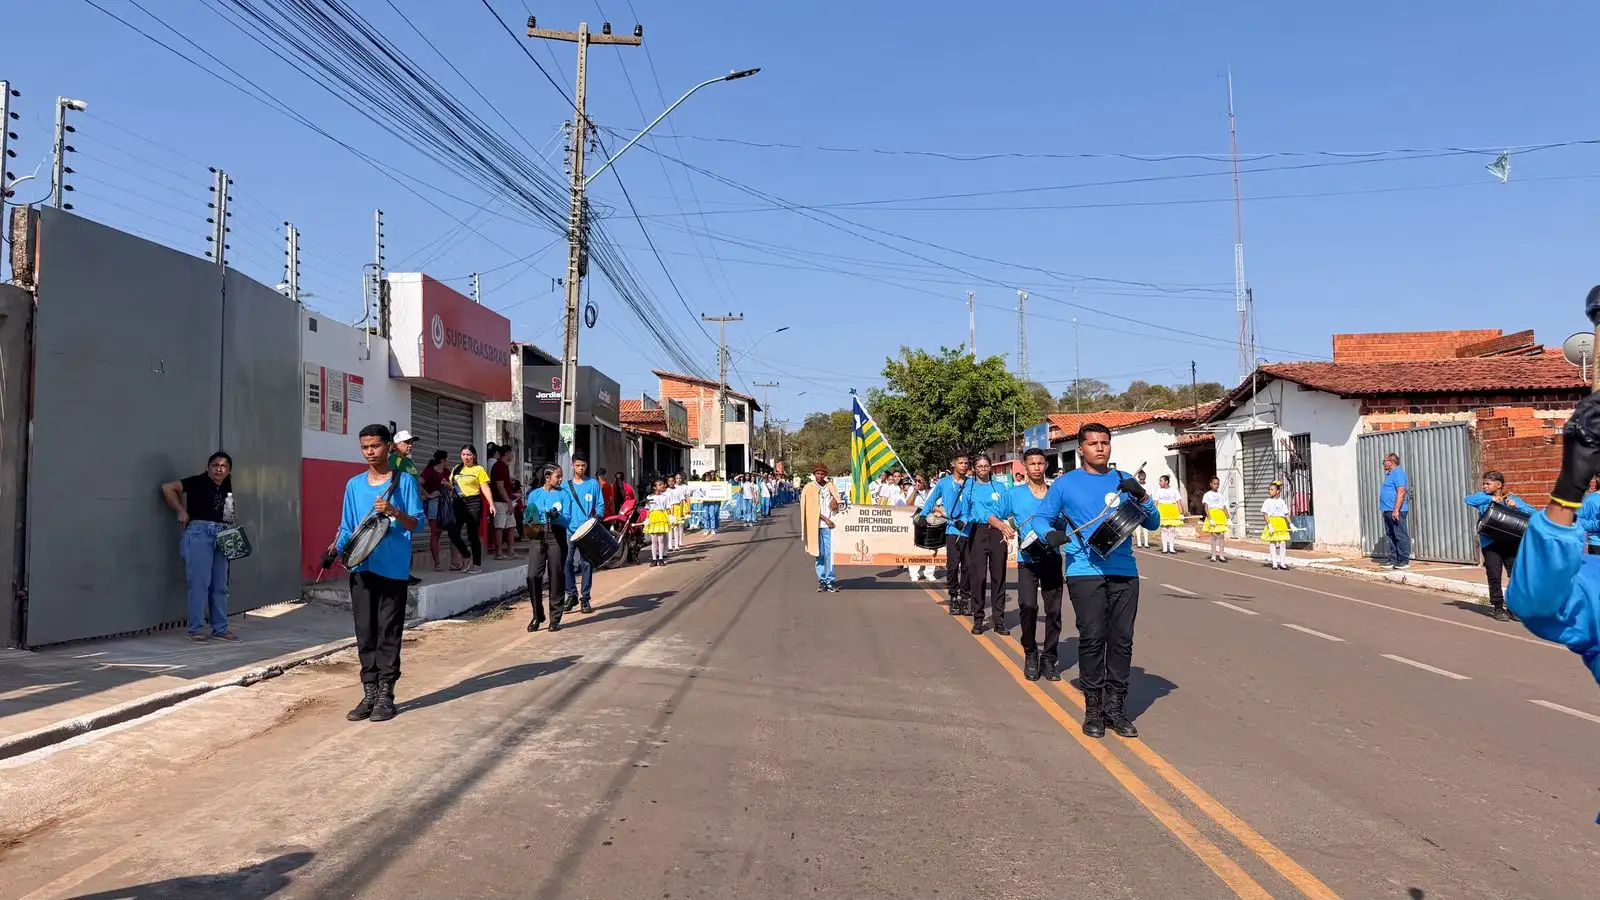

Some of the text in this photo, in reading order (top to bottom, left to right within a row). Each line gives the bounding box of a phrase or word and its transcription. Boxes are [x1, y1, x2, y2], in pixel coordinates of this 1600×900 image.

[445, 328, 508, 367] SUPERGASBRAS
[859, 509, 870, 517] DO
[871, 525, 909, 533] CORAGEM!
